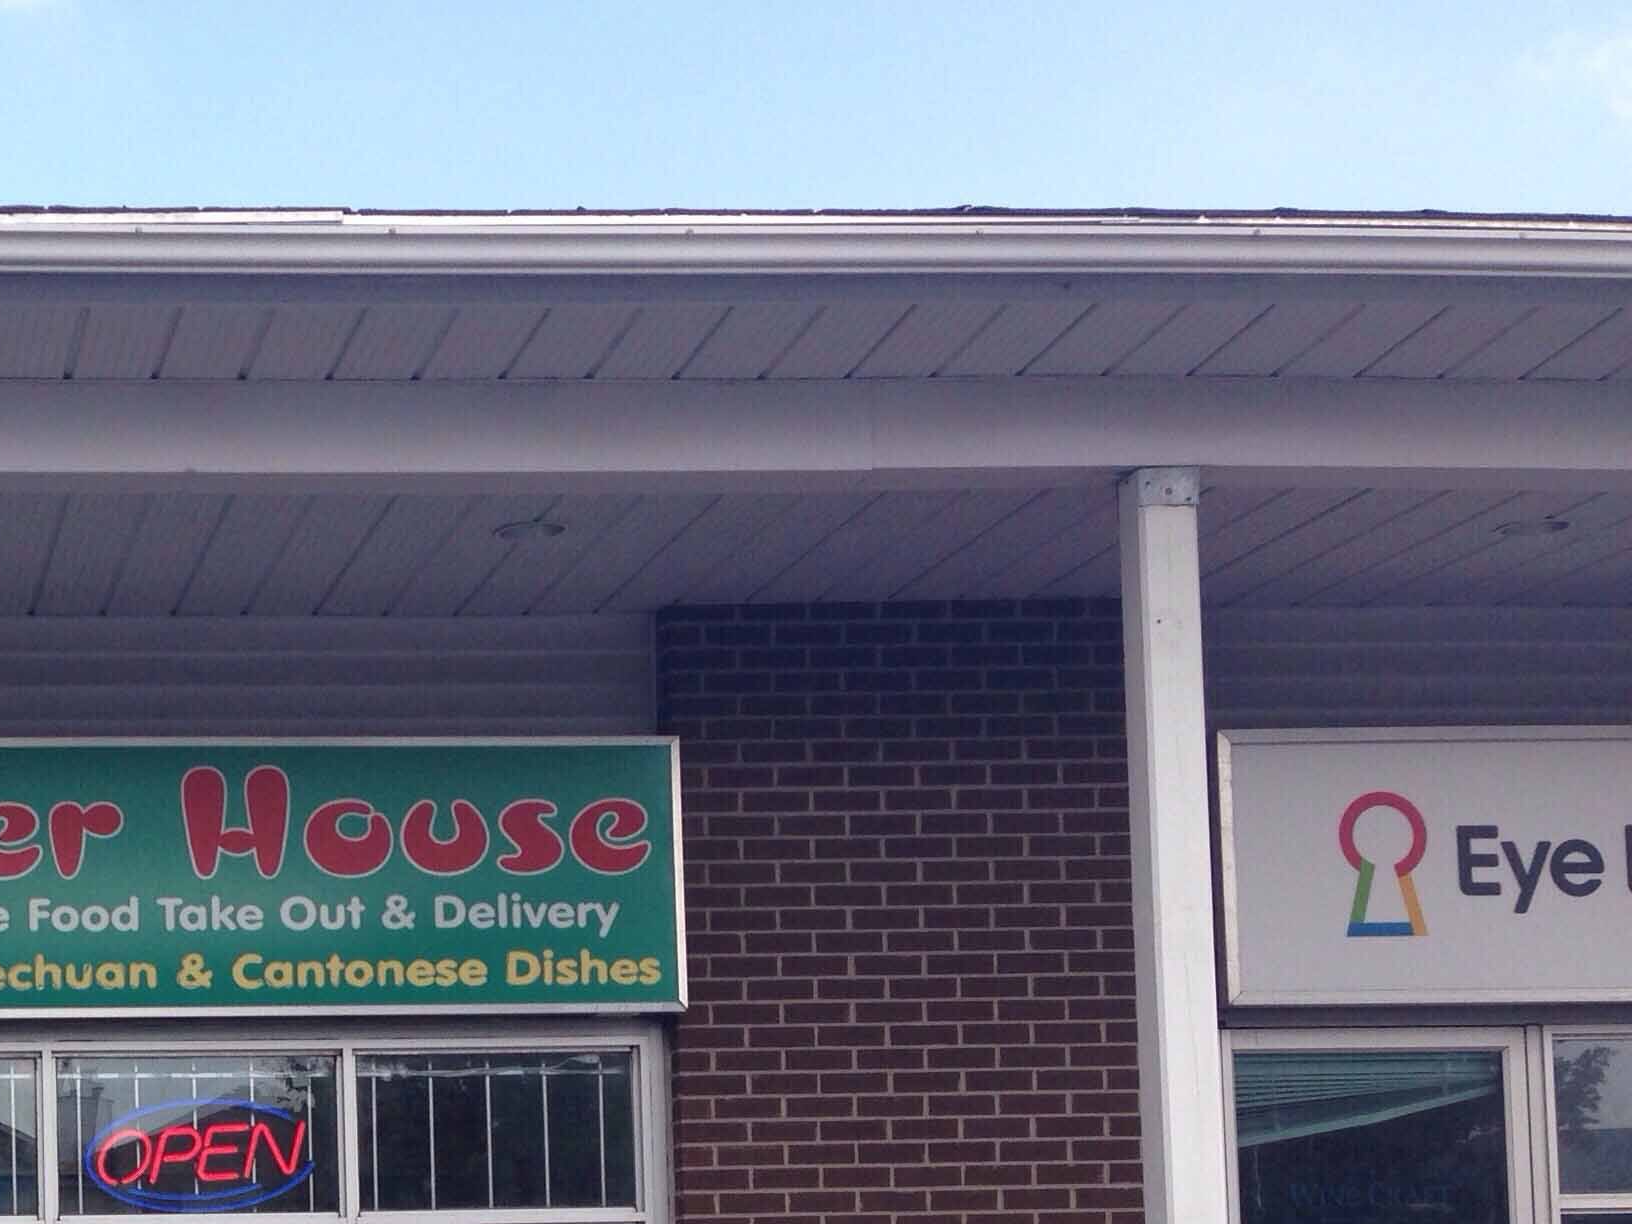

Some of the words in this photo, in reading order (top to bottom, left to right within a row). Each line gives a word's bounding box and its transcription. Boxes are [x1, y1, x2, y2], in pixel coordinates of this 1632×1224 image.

[180, 765, 652, 881] House
[1455, 823, 1606, 915] Eye
[28, 895, 140, 932] Food
[156, 895, 265, 931] Take
[279, 895, 366, 931] Out
[381, 894, 417, 930] &
[433, 893, 620, 938] Delivery
[175, 953, 214, 989] &
[231, 952, 489, 989] Cantonese
[504, 949, 663, 987] Dishes
[96, 1119, 306, 1186] OPEN
